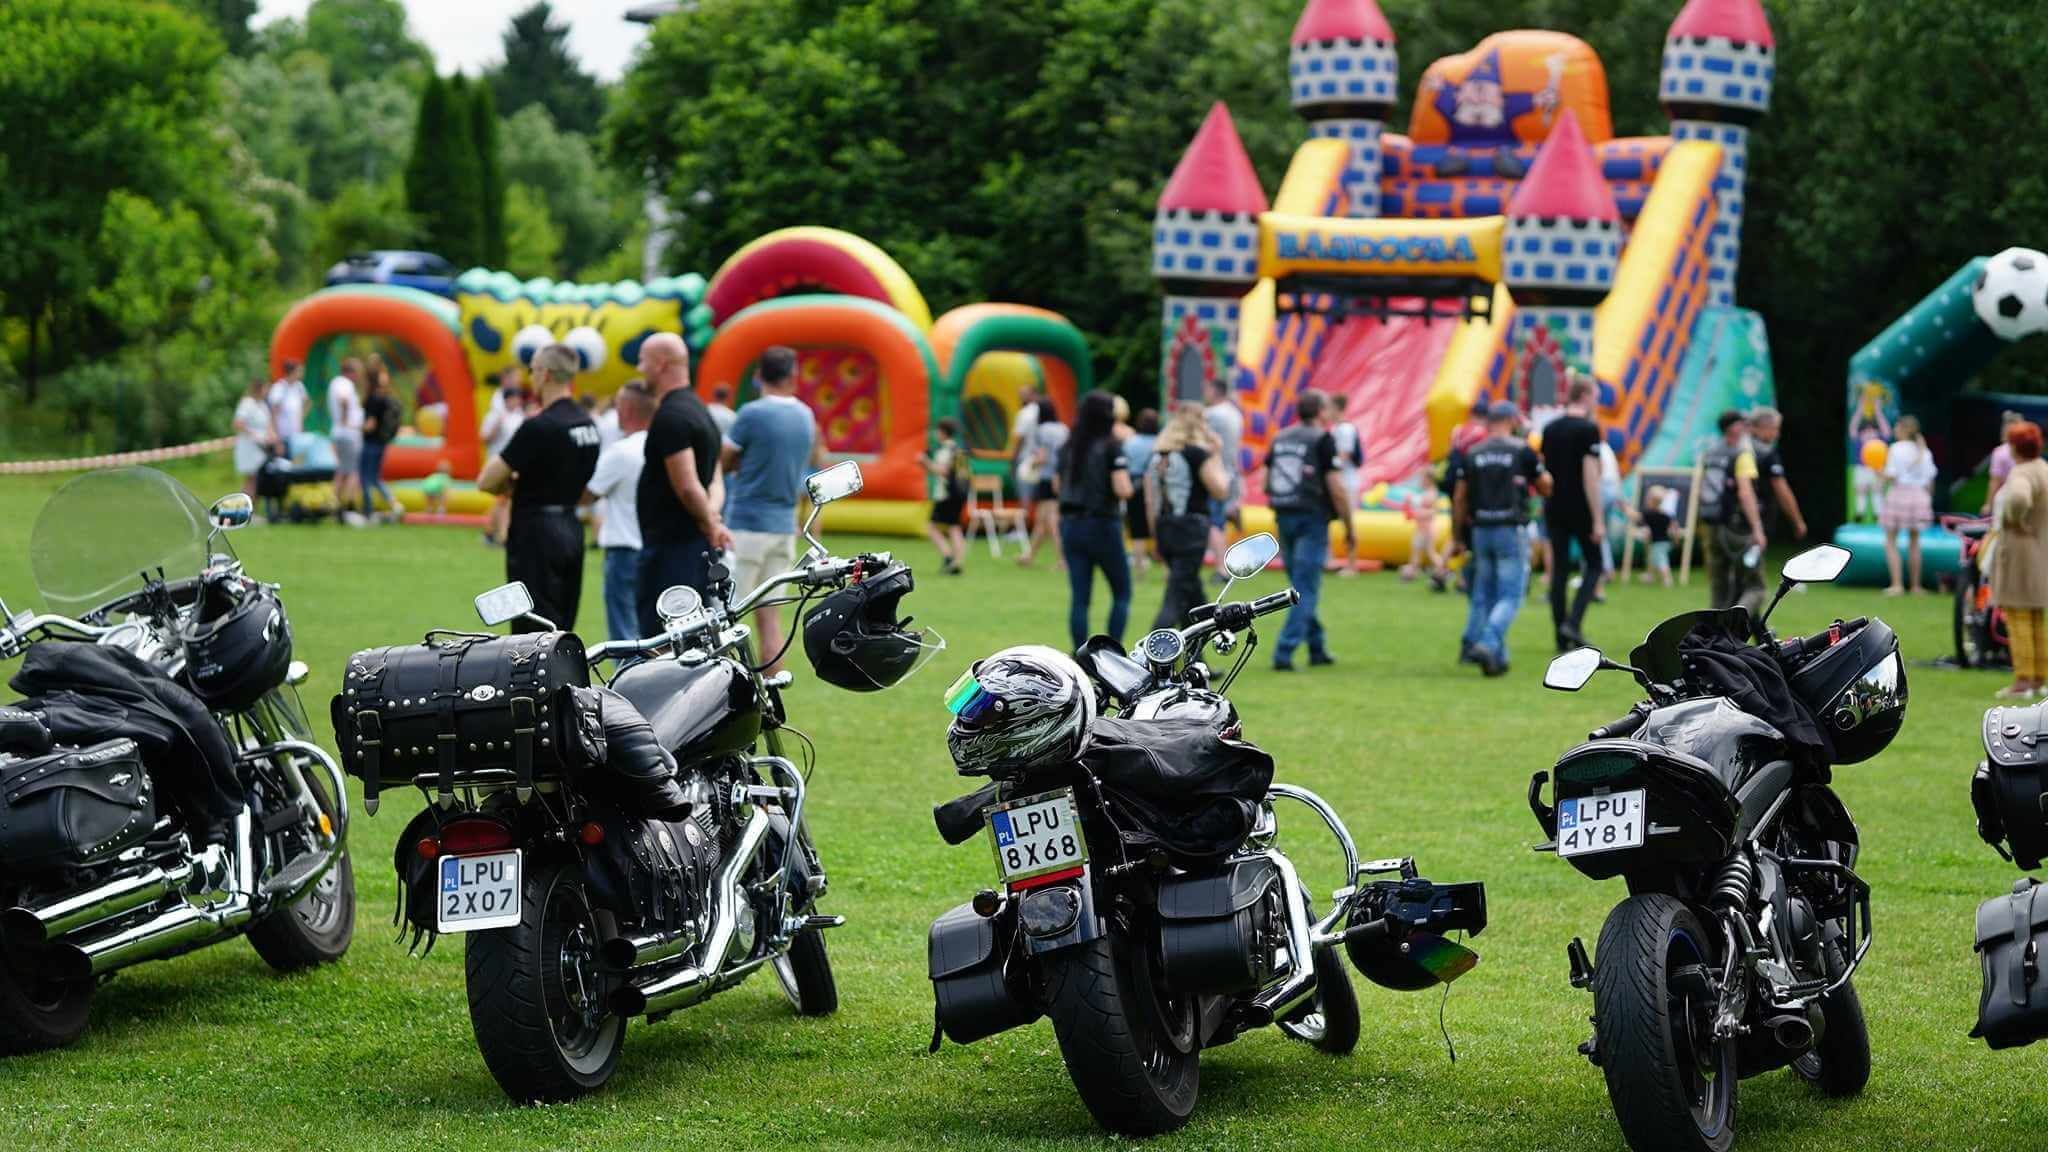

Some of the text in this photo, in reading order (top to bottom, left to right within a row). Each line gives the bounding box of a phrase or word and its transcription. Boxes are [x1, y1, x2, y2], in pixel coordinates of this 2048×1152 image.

[1012, 806, 1059, 838] LPU
[1562, 815, 1576, 826] PL
[1580, 797, 1626, 822] LPU
[998, 831, 1013, 844] PL
[1564, 822, 1632, 849] 4Y81
[1006, 834, 1076, 869] 8X68
[444, 877, 457, 889] PL
[461, 860, 503, 886] LPU
[447, 888, 513, 915] 2X07
